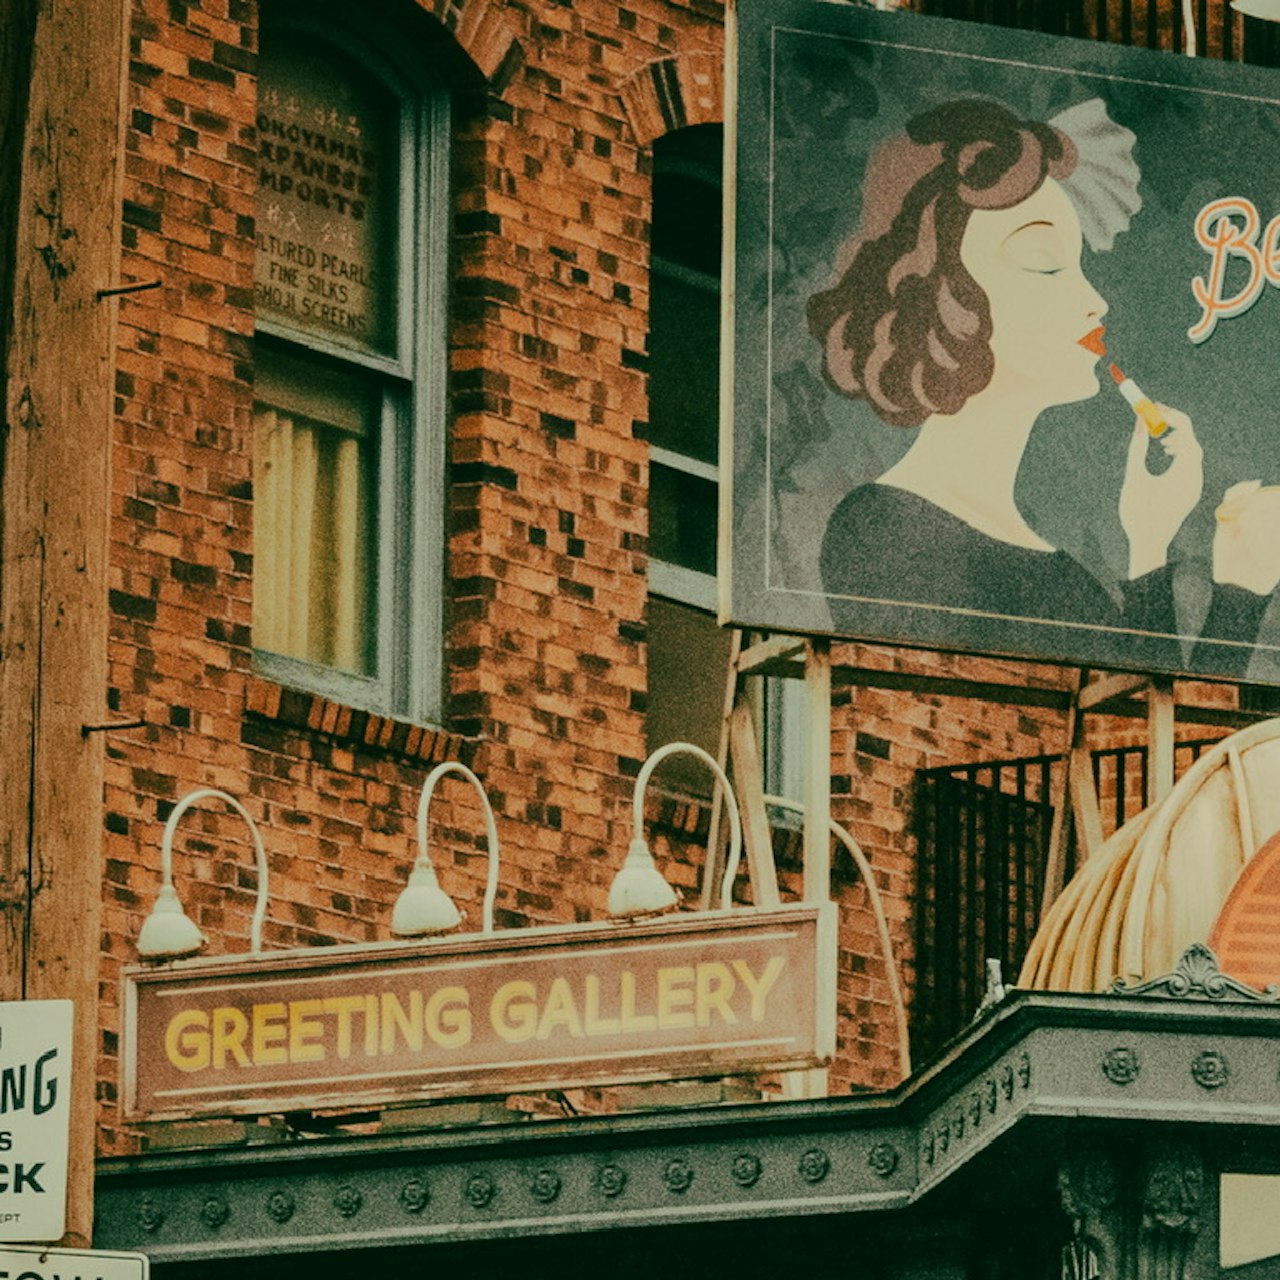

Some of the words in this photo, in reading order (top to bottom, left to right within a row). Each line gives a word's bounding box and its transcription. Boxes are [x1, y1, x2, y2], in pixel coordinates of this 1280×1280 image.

[269, 260, 299, 289] FINE
[306, 273, 348, 304] SILKS
[300, 296, 369, 332] SCREENS
[164, 983, 474, 1074] GREETING
[490, 955, 787, 1045] GALLERY
